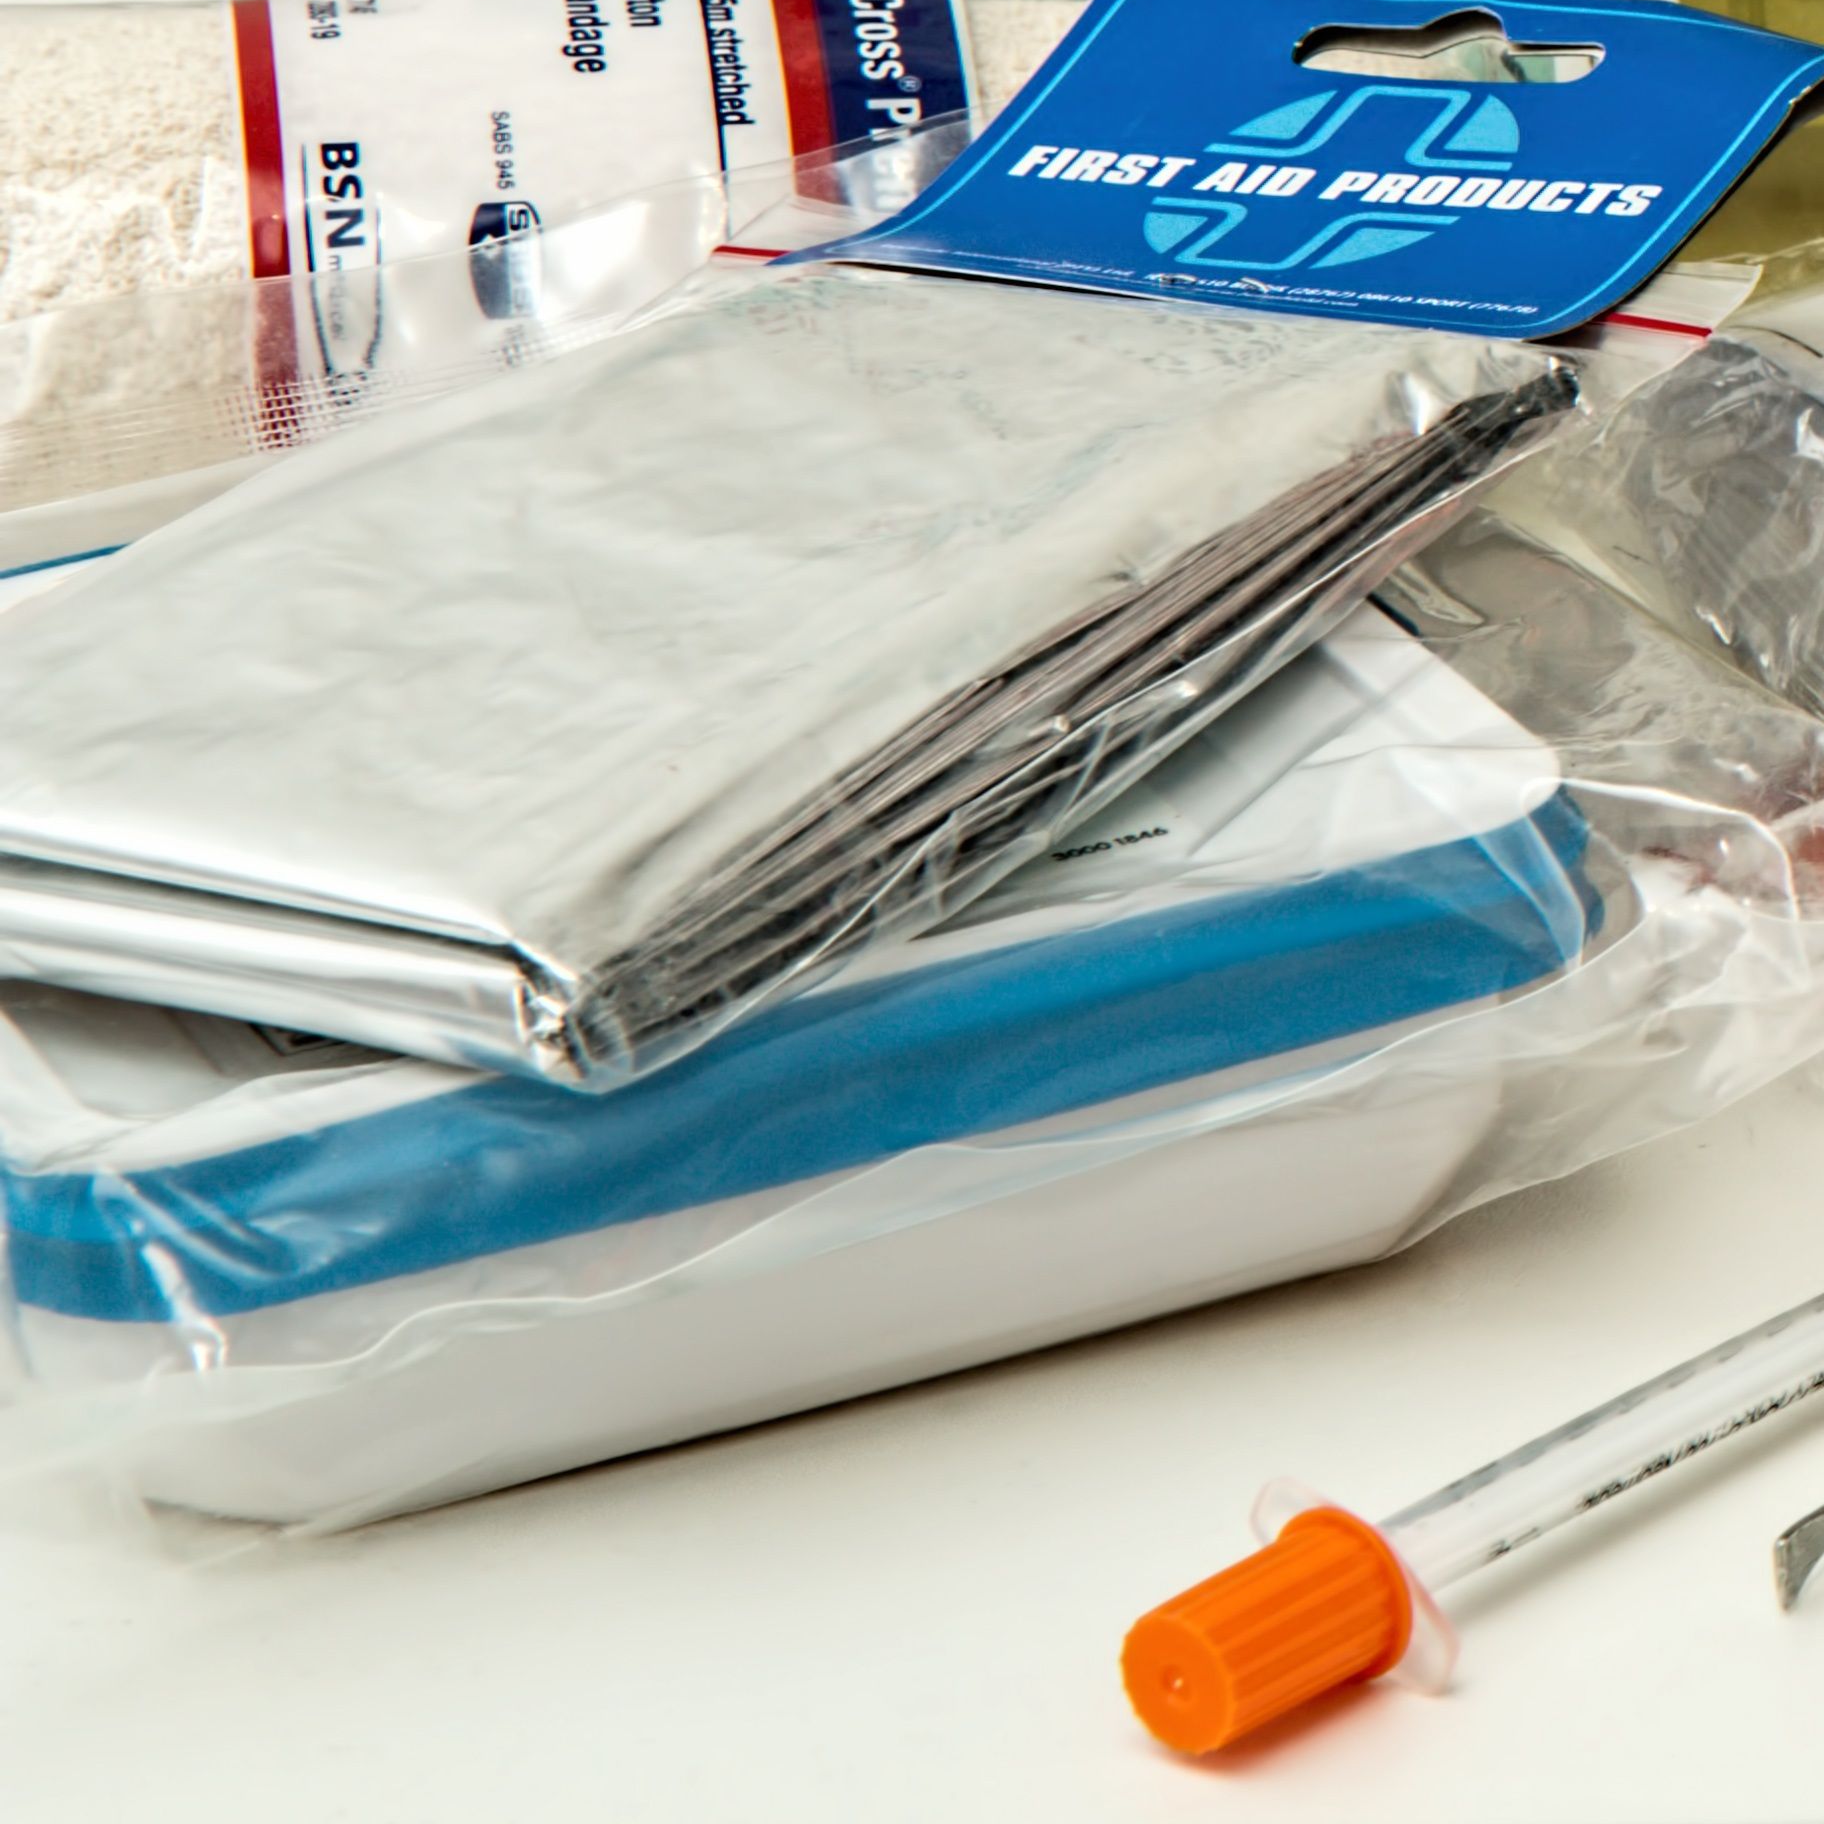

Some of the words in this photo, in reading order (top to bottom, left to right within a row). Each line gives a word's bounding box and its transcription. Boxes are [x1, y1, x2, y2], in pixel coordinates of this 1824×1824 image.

[710, 26, 756, 126] stretched
[319, 141, 367, 250] BSN
[1007, 143, 1197, 190] FIRST
[1190, 160, 1320, 199] AID
[1322, 170, 1664, 218] PRODUCTS
